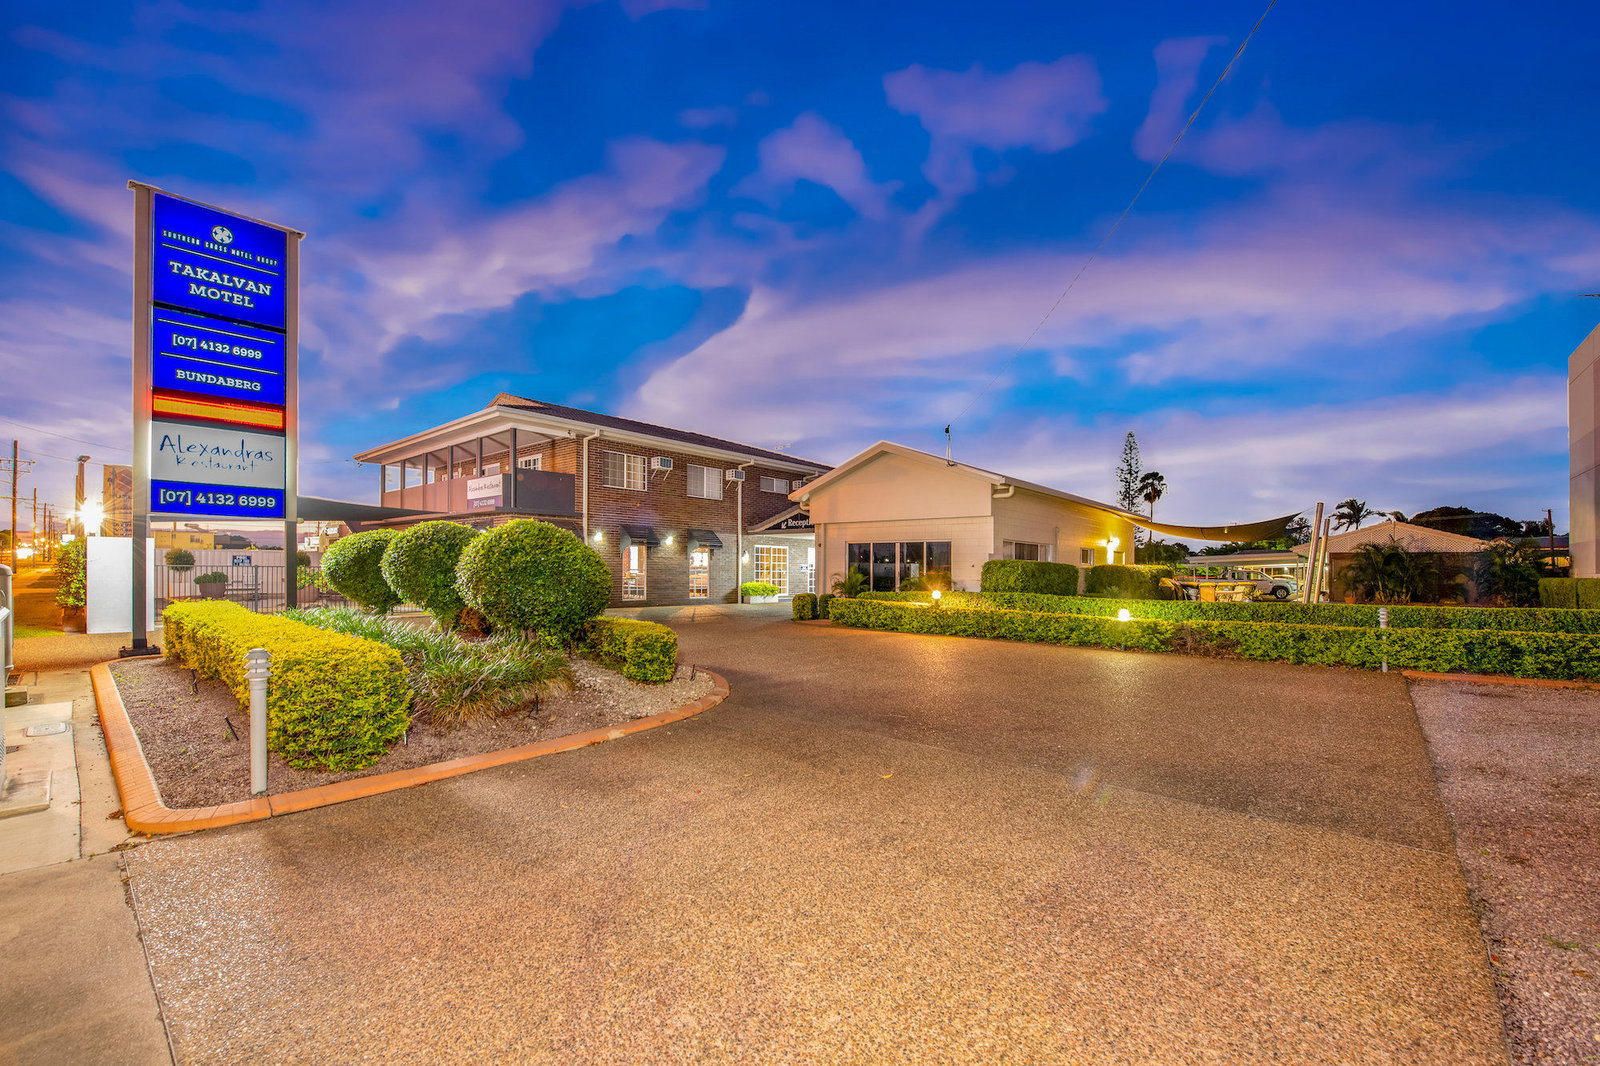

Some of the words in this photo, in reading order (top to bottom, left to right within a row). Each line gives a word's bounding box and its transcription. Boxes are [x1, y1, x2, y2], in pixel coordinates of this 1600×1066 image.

[163, 229, 200, 245] SOUTHERN
[205, 241, 228, 253] CROSS
[231, 248, 253, 260] MOTEL
[169, 260, 272, 296] TAKALVAN
[189, 283, 254, 308] MOTEL
[172, 334, 197, 350] [07]
[200, 338, 230, 354] 4132
[232, 347, 262, 359] 6999
[176, 369, 261, 391] BUNDABERG
[160, 434, 273, 462] Alexandras
[160, 488, 191, 506] [07]
[196, 492, 235, 506] 4132
[238, 495, 276, 508] 6999
[788, 518, 814, 528] Recept
